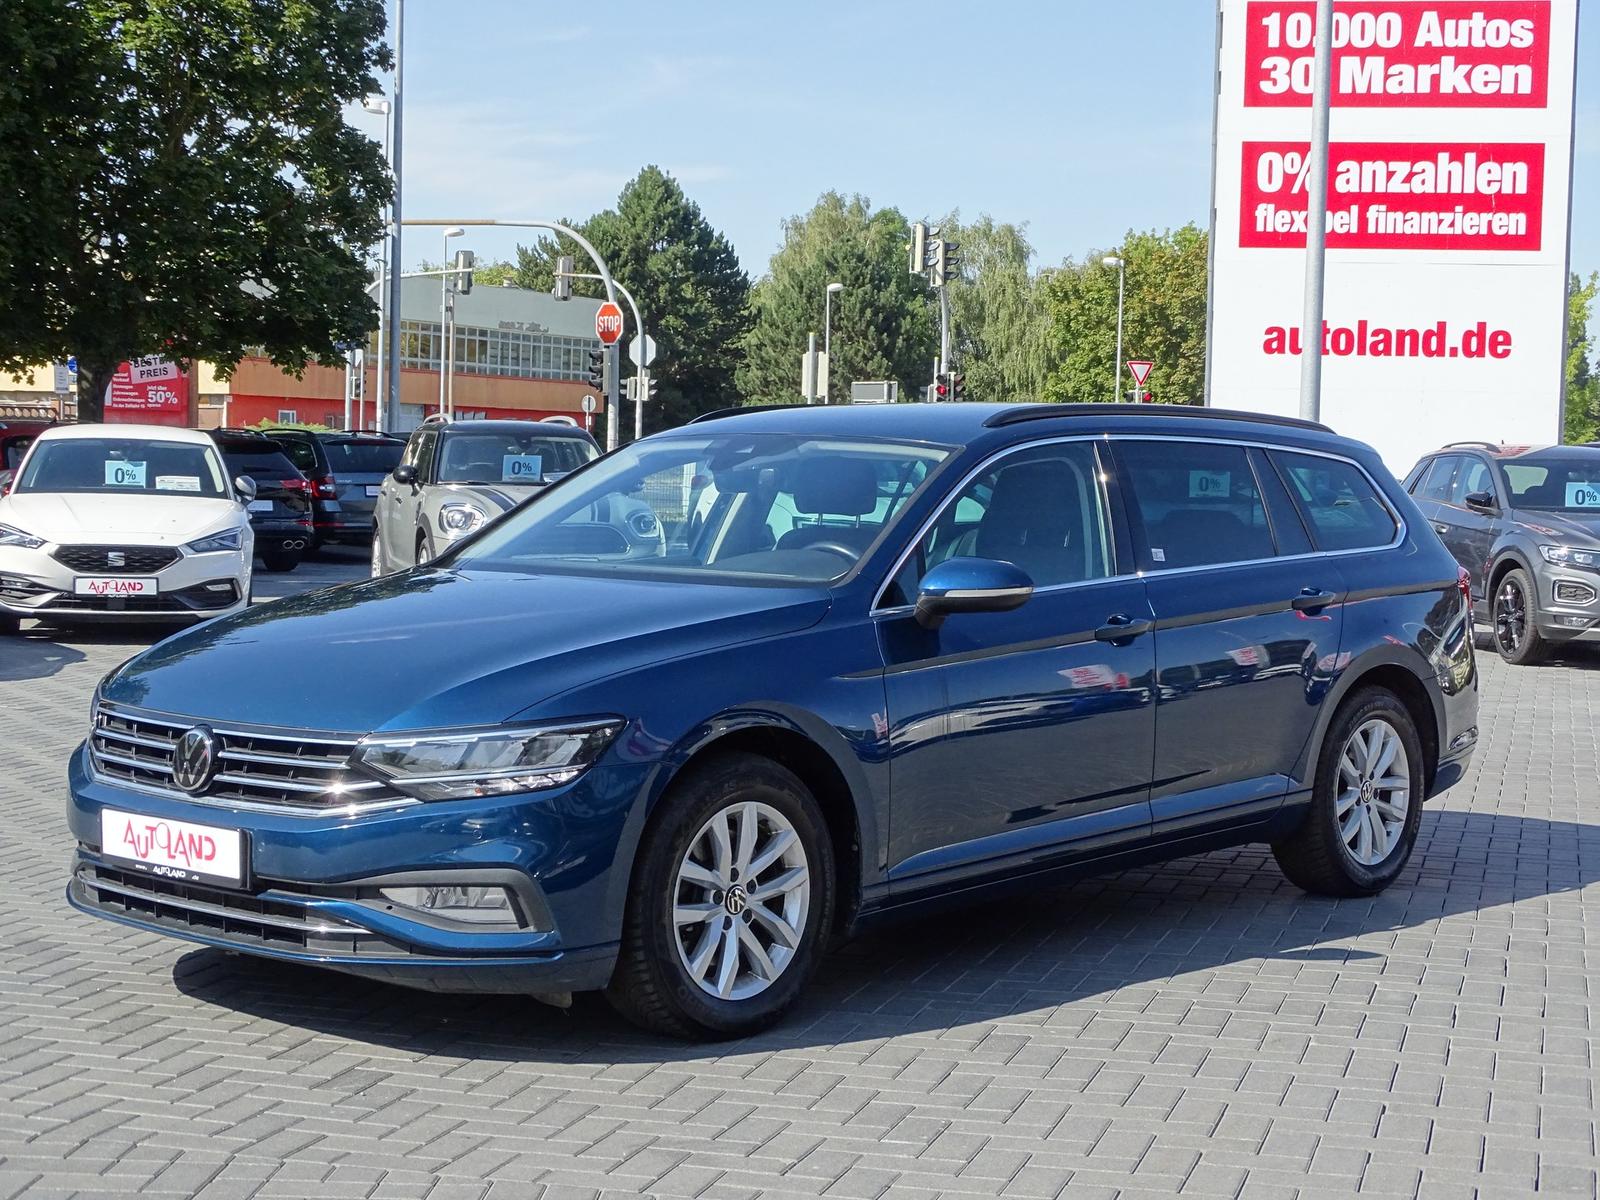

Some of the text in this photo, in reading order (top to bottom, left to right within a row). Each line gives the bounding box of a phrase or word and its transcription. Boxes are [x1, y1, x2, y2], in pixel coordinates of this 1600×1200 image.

[1414, 11, 1534, 48] Autos
[1259, 55, 1533, 95] 30 Marken
[1256, 151, 1528, 194] 0% anzahlen
[1366, 205, 1527, 235] finanzieren
[598, 315, 620, 332] STOP
[139, 367, 169, 379] PREIS
[147, 391, 178, 404] 50%
[115, 468, 136, 483] 0%
[512, 461, 532, 475] 0%
[1199, 477, 1221, 491] 0%
[1575, 489, 1598, 506] 0%
[88, 580, 144, 594] AUTOLAND
[123, 819, 216, 867] AUTOLAND
